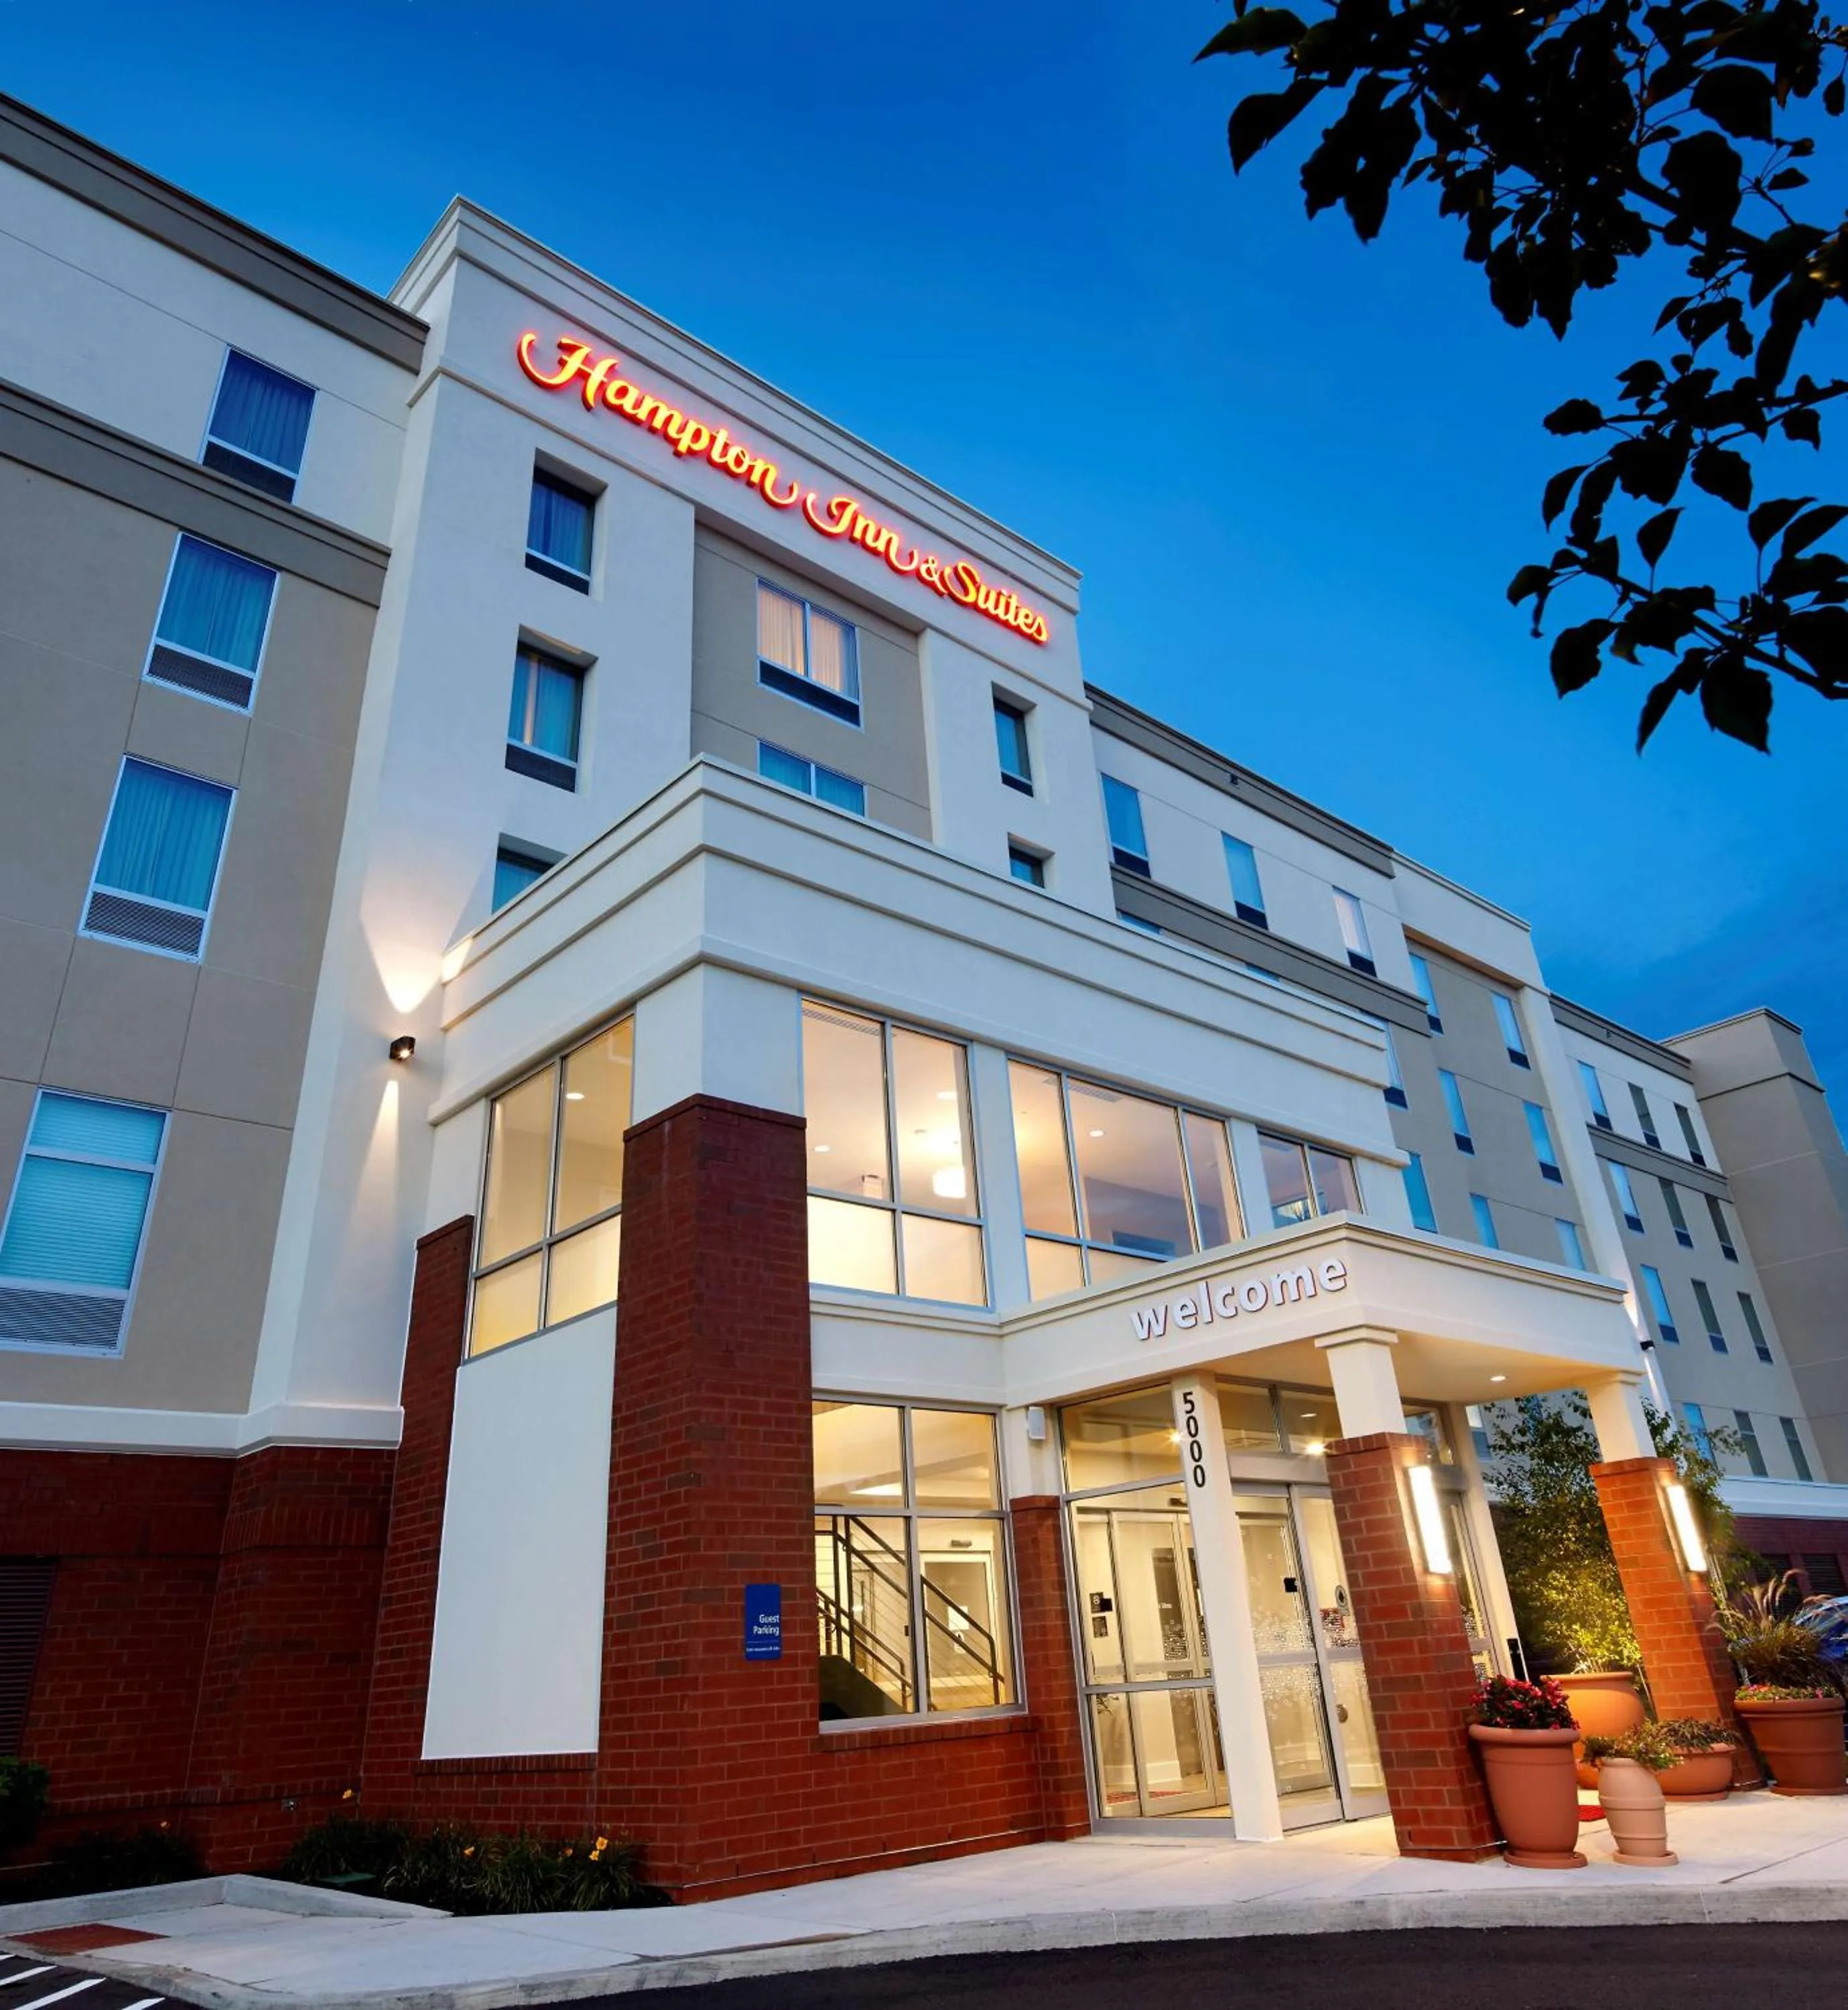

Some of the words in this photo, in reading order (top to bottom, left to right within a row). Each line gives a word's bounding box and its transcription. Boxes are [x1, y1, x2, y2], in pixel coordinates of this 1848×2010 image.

[517, 333, 799, 509] Hampton
[803, 492, 919, 576] Inn
[939, 561, 1049, 646] Suites
[1129, 1257, 1348, 1341] welcome
[1182, 1391, 1206, 1488] 5000
[752, 1625, 779, 1636] Parking
[758, 1614, 779, 1623] Guest
